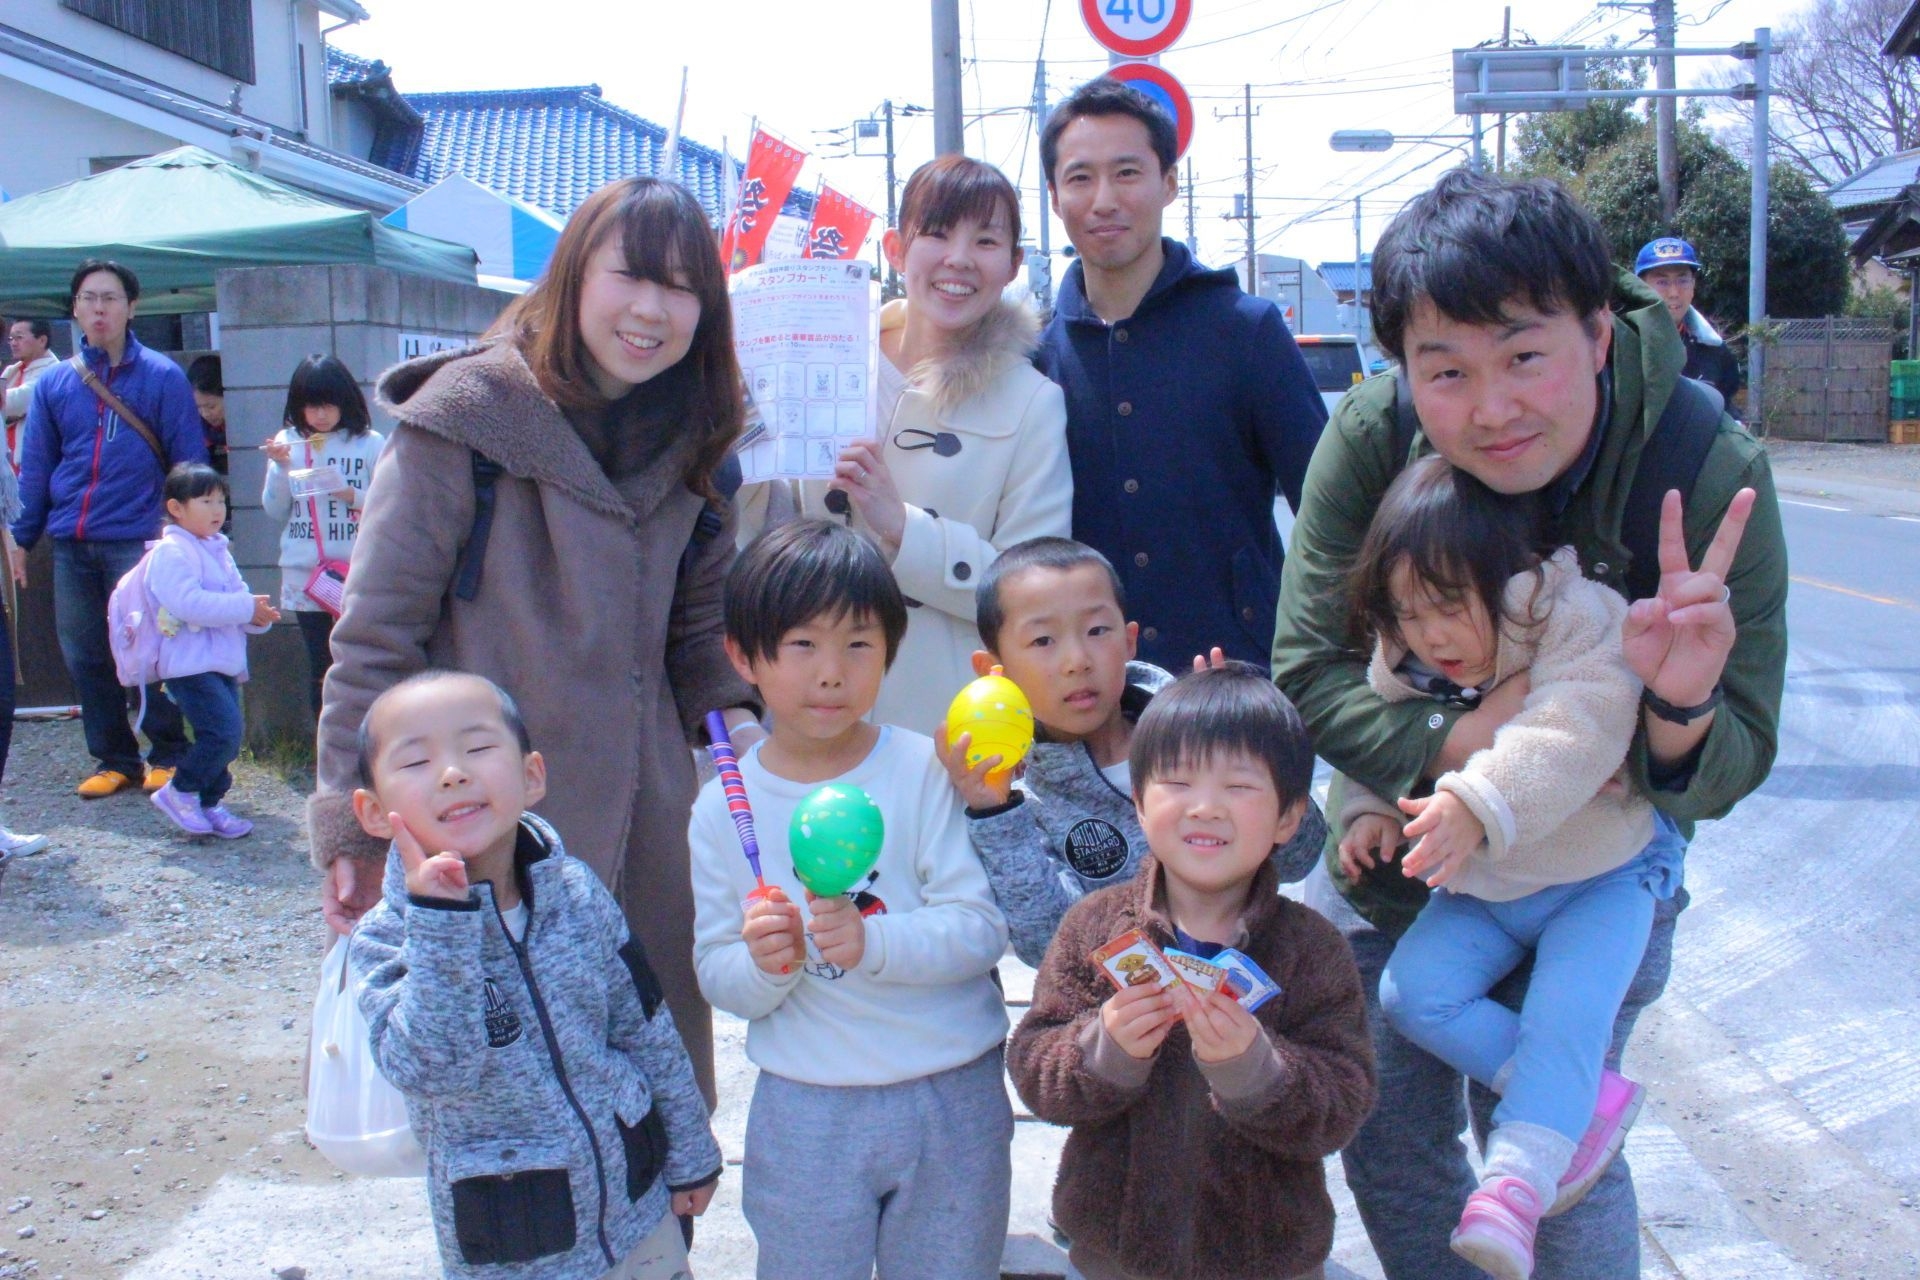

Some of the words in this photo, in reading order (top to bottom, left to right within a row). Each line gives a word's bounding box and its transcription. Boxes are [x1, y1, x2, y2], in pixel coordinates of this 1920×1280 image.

[1106, 0, 1165, 24] 40
[759, 272, 829, 286] スタンプカード
[288, 522, 315, 540] ROSE
[1070, 821, 1114, 847] ORIGINAL
[1073, 836, 1120, 859] STANDARD
